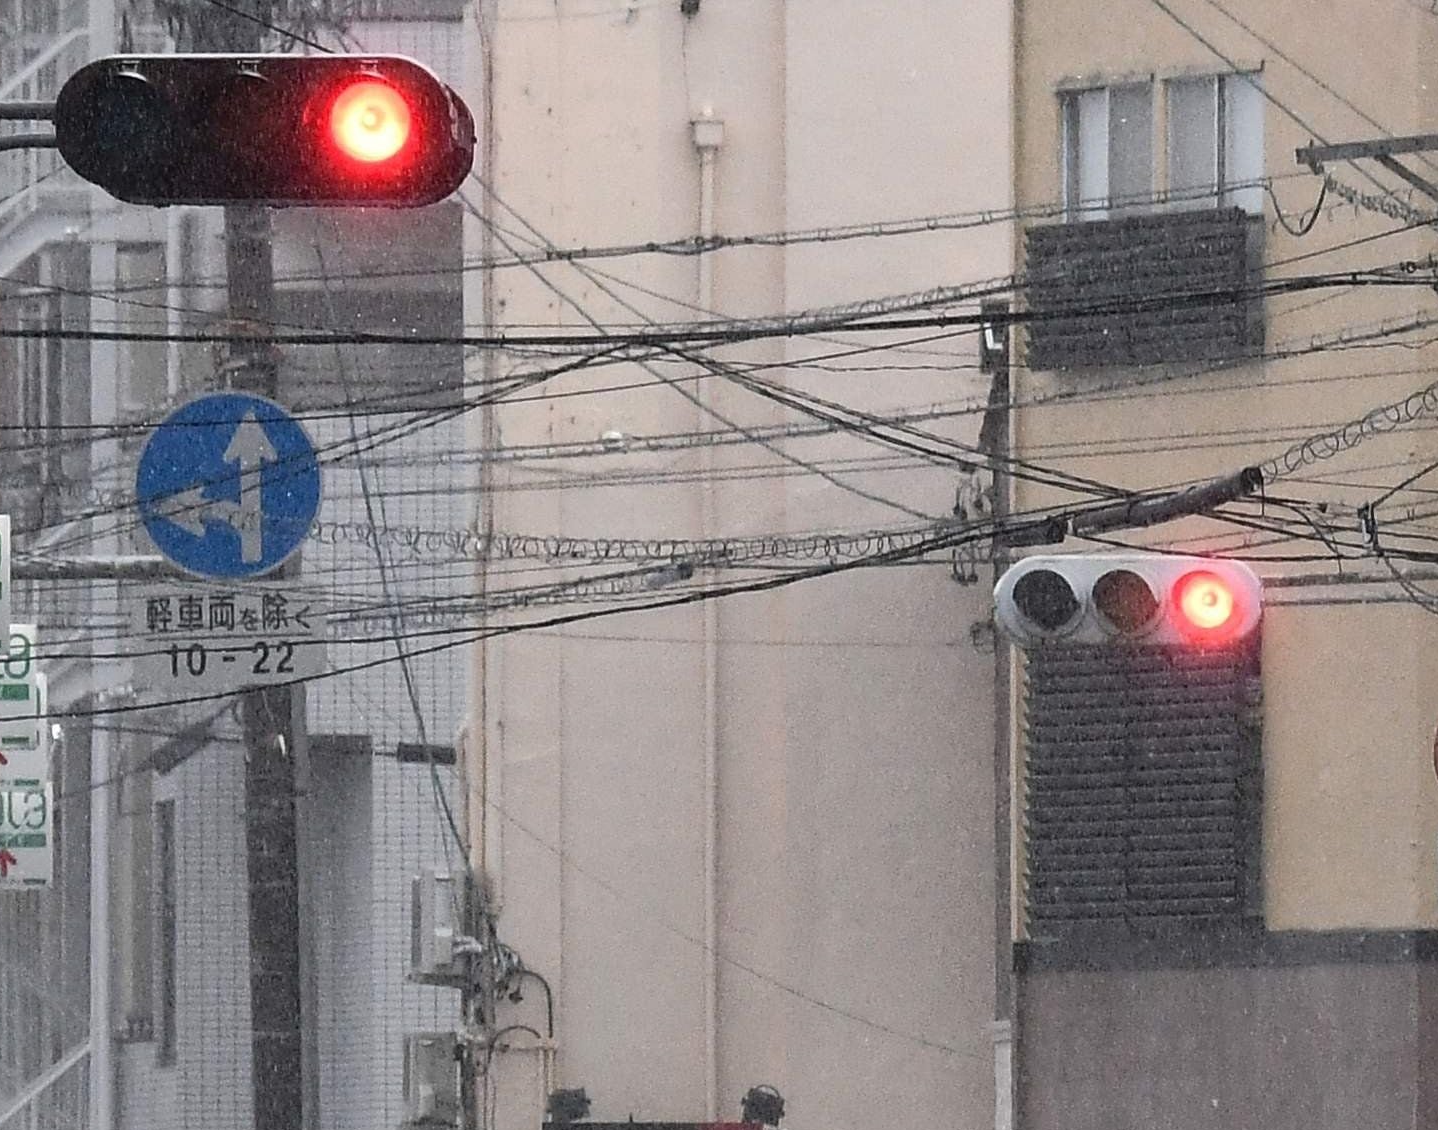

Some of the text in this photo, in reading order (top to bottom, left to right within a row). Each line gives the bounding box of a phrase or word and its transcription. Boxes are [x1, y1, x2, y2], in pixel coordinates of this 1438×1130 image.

[146, 592, 312, 634] 軽車両を除く
